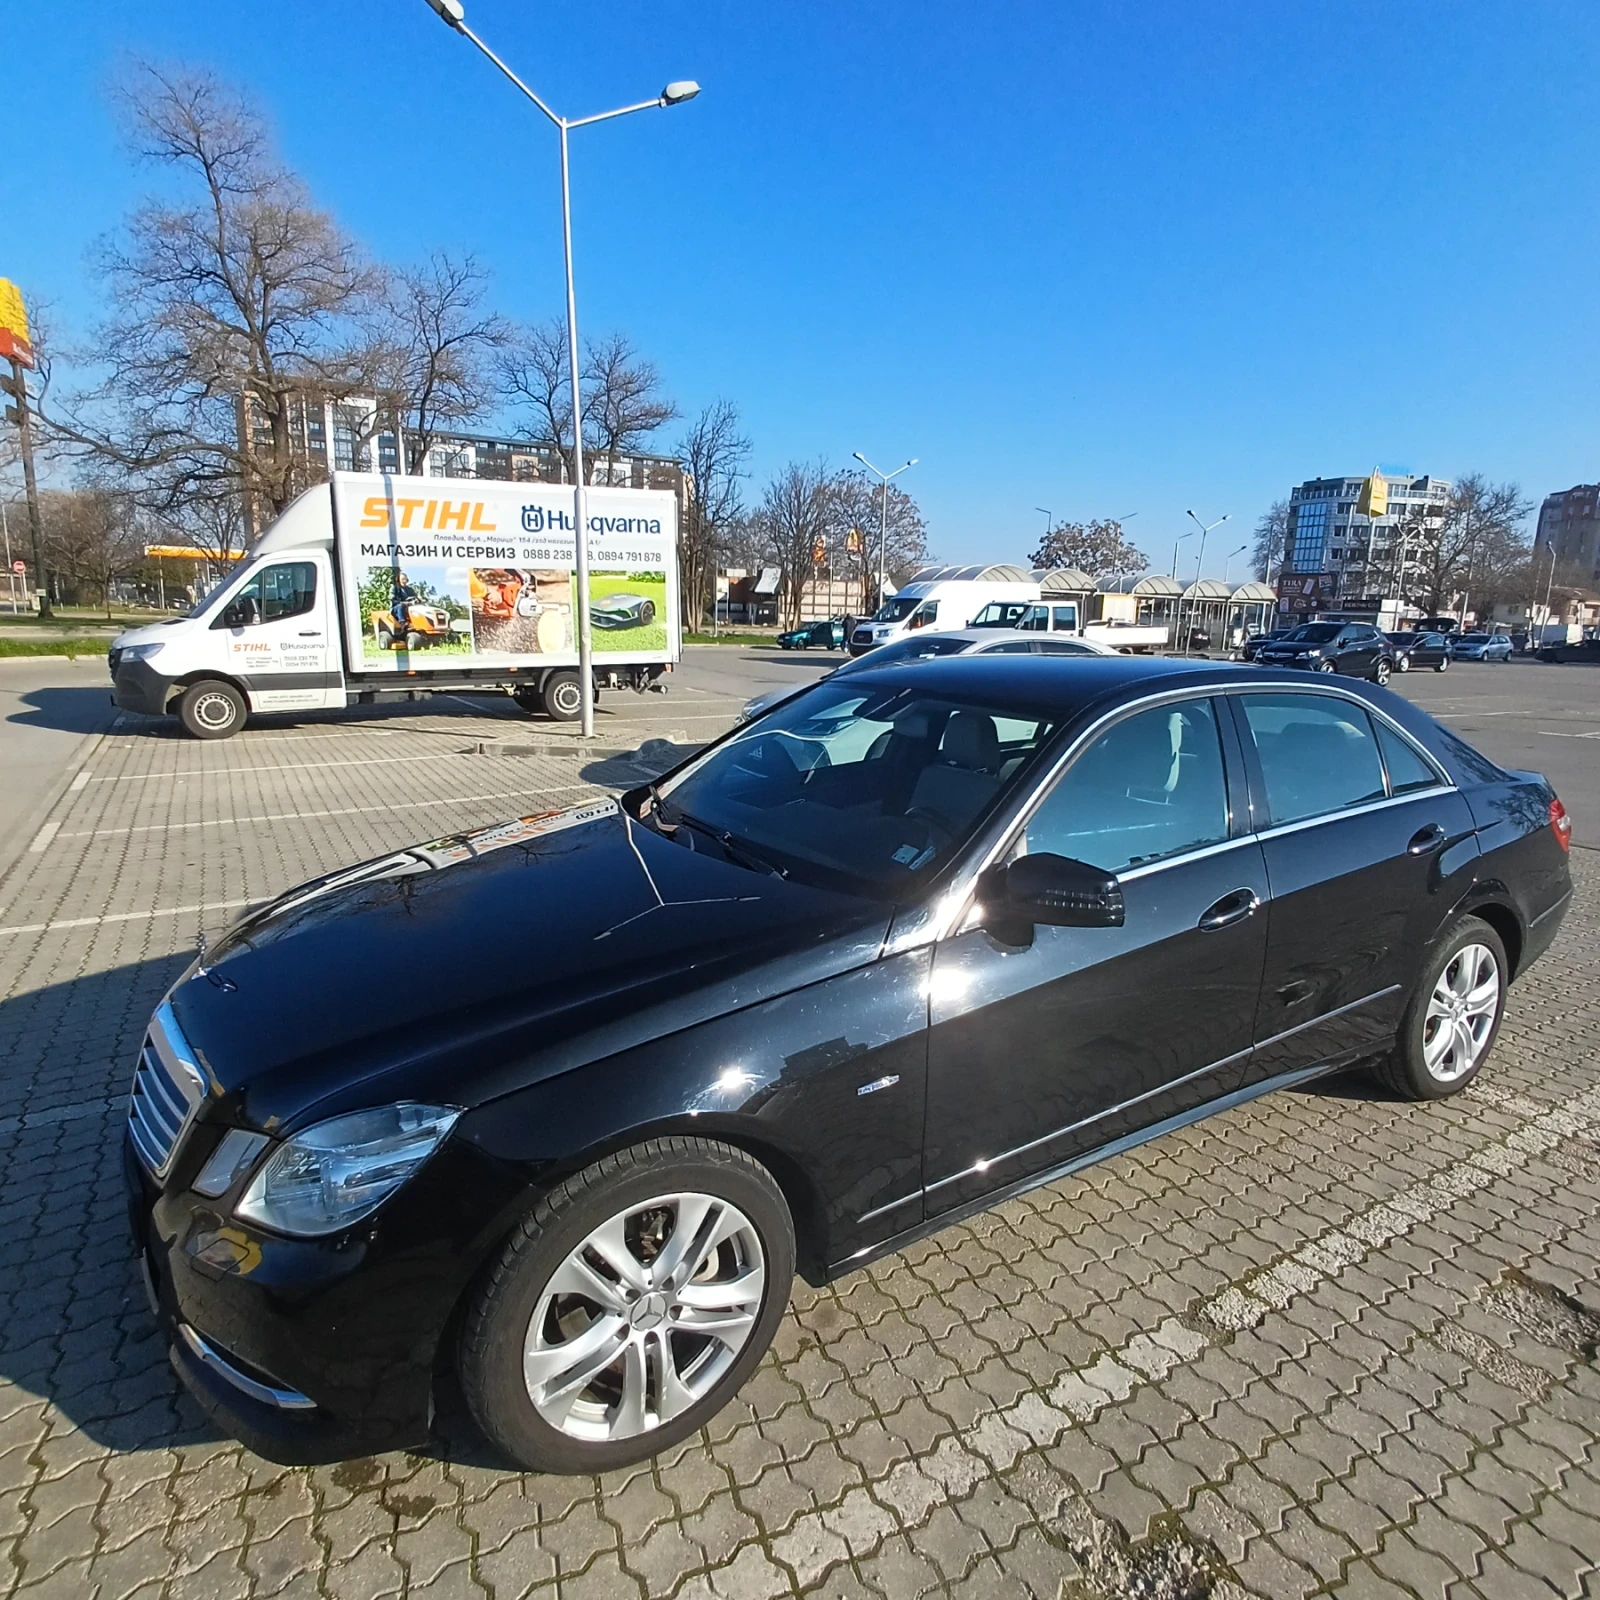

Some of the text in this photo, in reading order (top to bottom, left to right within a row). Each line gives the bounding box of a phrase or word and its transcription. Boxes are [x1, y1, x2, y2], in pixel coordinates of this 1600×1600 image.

[360, 497, 497, 531] STIHL
[360, 544, 516, 559] МАГАЗИН И СЕРВИЗ
[523, 549, 551, 560] 0888
[553, 549, 573, 560] 238
[597, 551, 624, 561] 0894
[625, 551, 642, 562] 791
[643, 552, 661, 562] 878
[233, 643, 271, 652] STIHL
